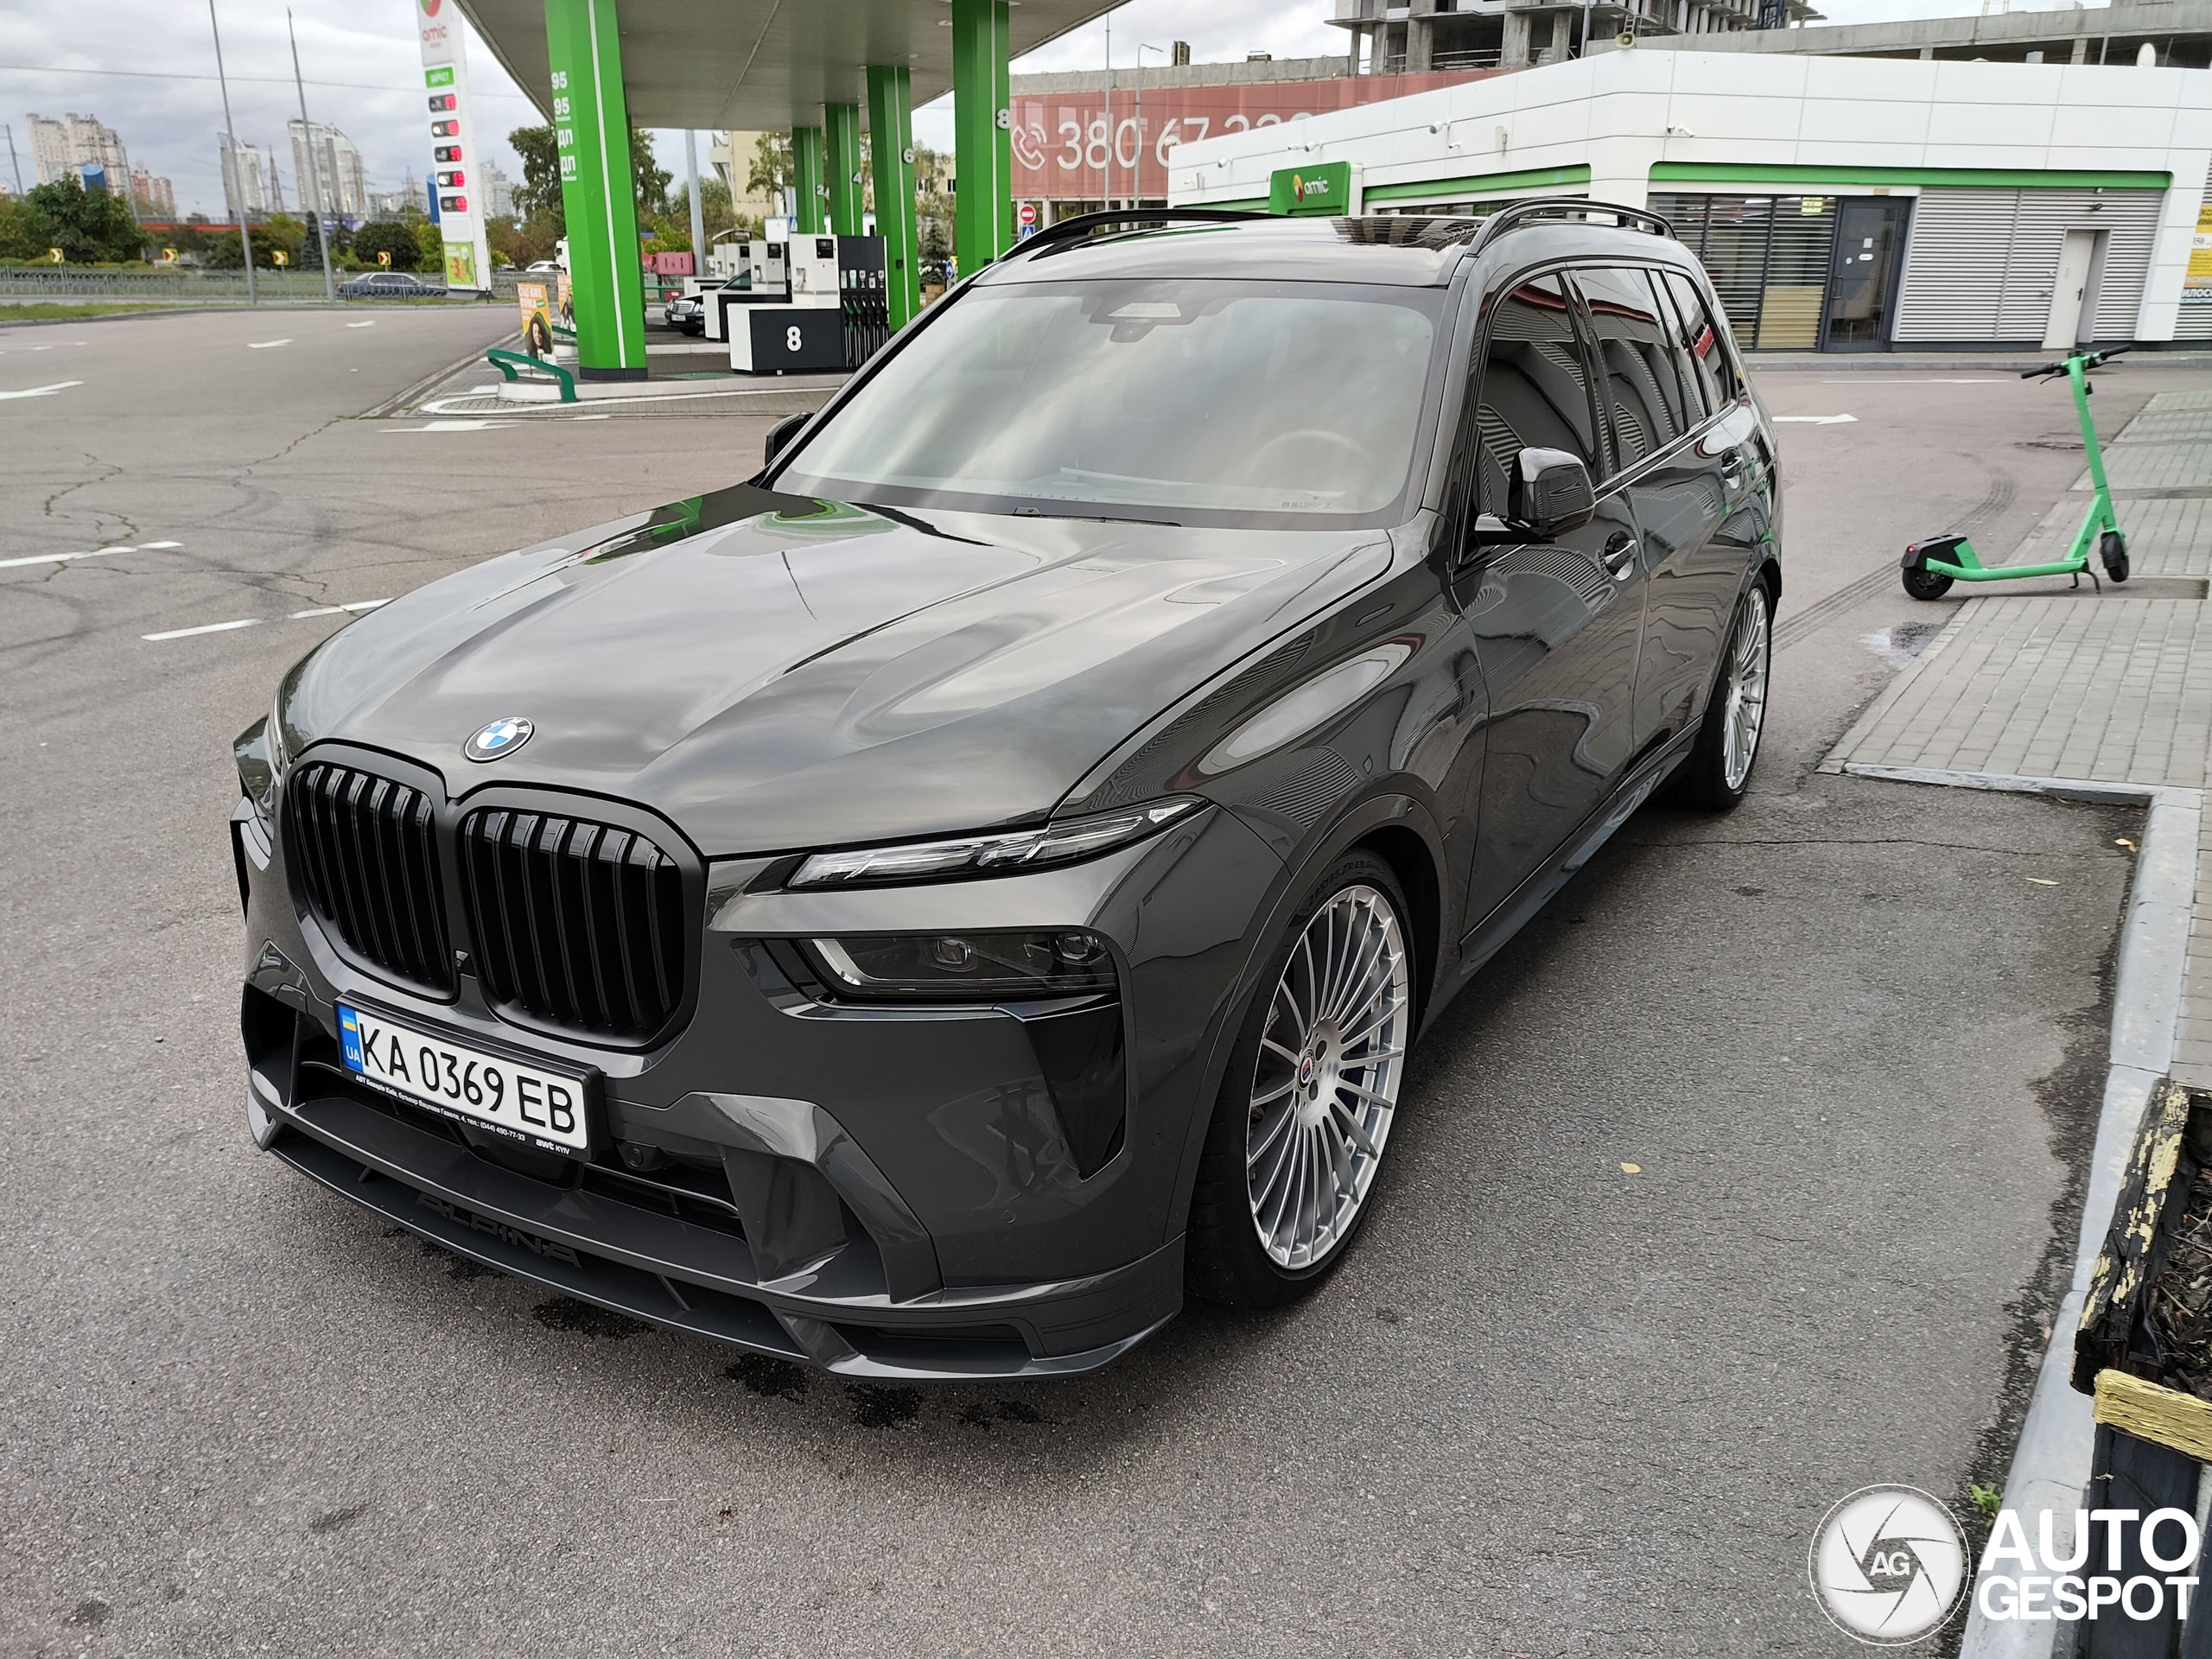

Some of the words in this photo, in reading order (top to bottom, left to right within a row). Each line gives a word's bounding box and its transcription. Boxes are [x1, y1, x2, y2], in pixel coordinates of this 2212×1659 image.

[551, 71, 568, 90] 95
[554, 97, 569, 116] 95
[996, 108, 1011, 130] 8
[557, 128, 574, 149] ДП
[1056, 118, 1142, 169] 380
[560, 156, 576, 175] ДП
[903, 148, 915, 164] 6
[852, 171, 862, 184] 4
[1304, 175, 1329, 194] amic
[817, 185, 824, 195] 2
[785, 325, 803, 353] 8
[346, 1045, 361, 1064] UA
[359, 1023, 411, 1083] KA
[419, 1046, 504, 1112] 0369
[517, 1074, 575, 1134] EB
[480, 1122, 496, 1133] (044)
[496, 1127, 525, 1141] 490-77-33
[536, 1139, 555, 1151] awt
[416, 1192, 582, 1268] ALPINA
